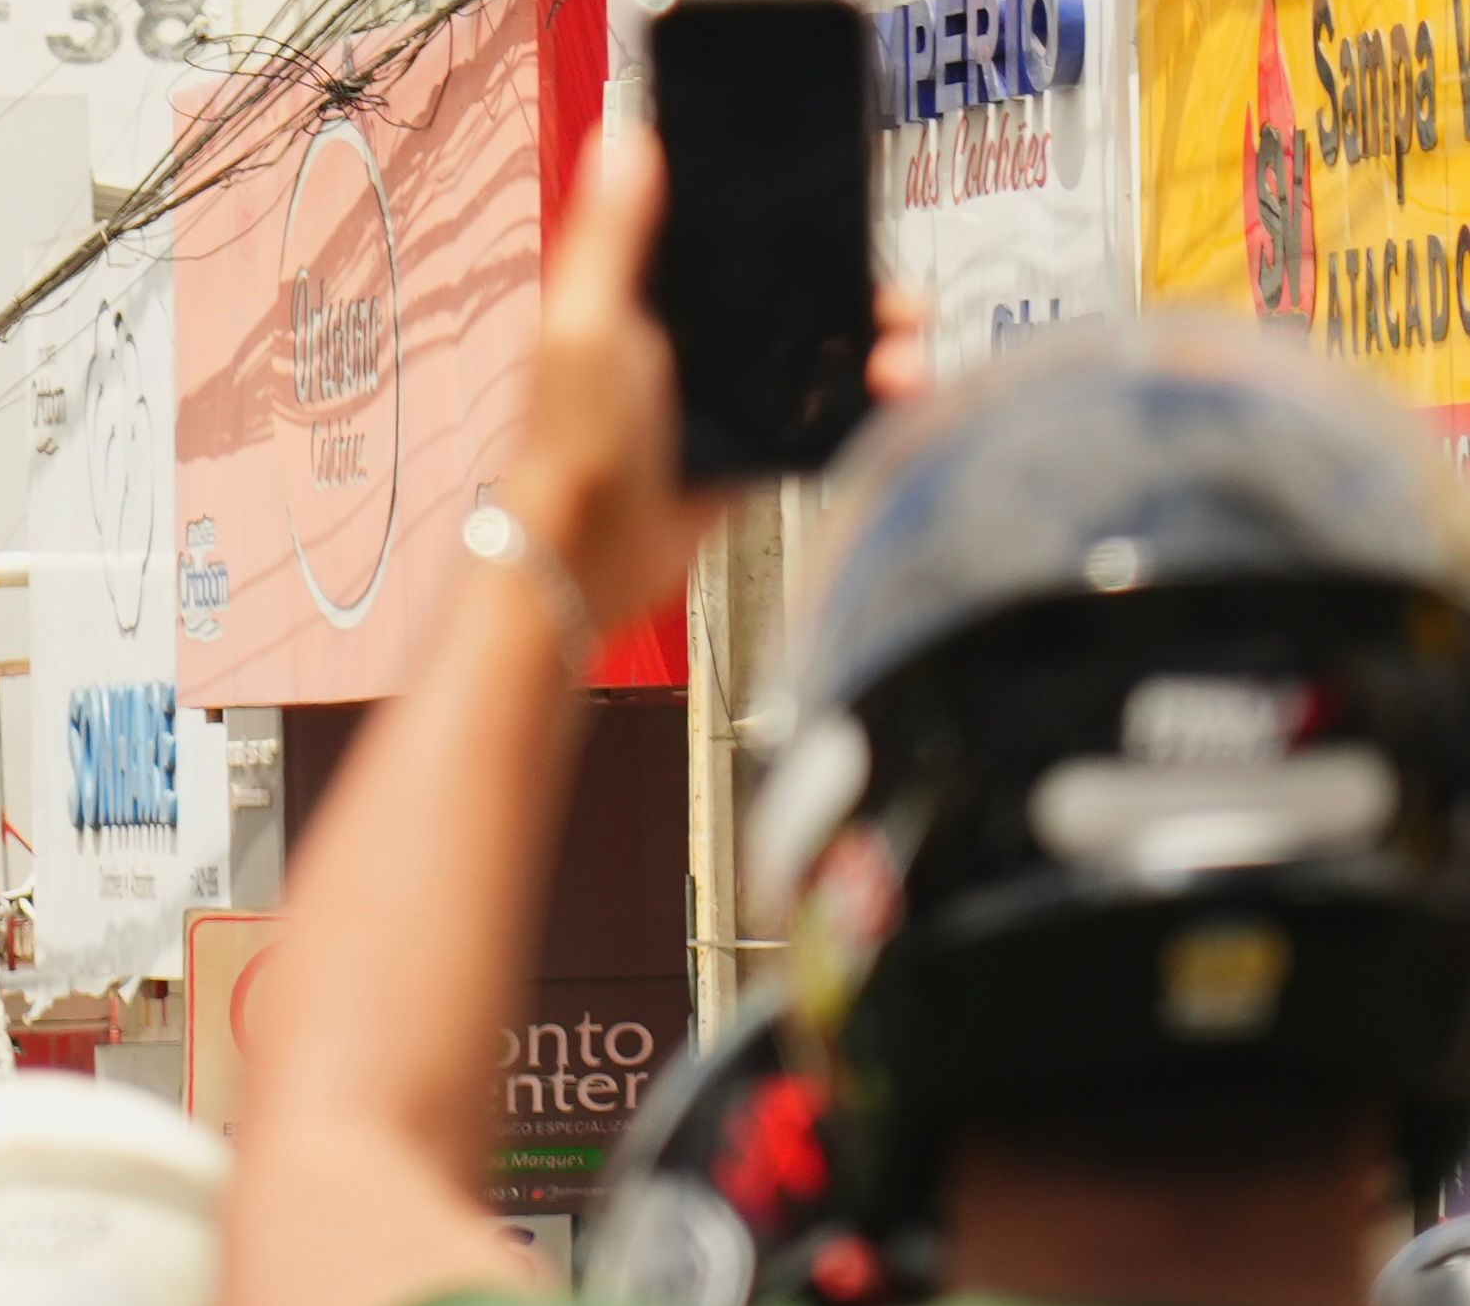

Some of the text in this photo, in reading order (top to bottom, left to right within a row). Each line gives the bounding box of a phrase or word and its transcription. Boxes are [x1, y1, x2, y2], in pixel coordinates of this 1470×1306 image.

[904, 109, 1051, 210] dos Colchões
[498, 1062, 650, 1114] nter
[510, 1151, 585, 1170] Marques
